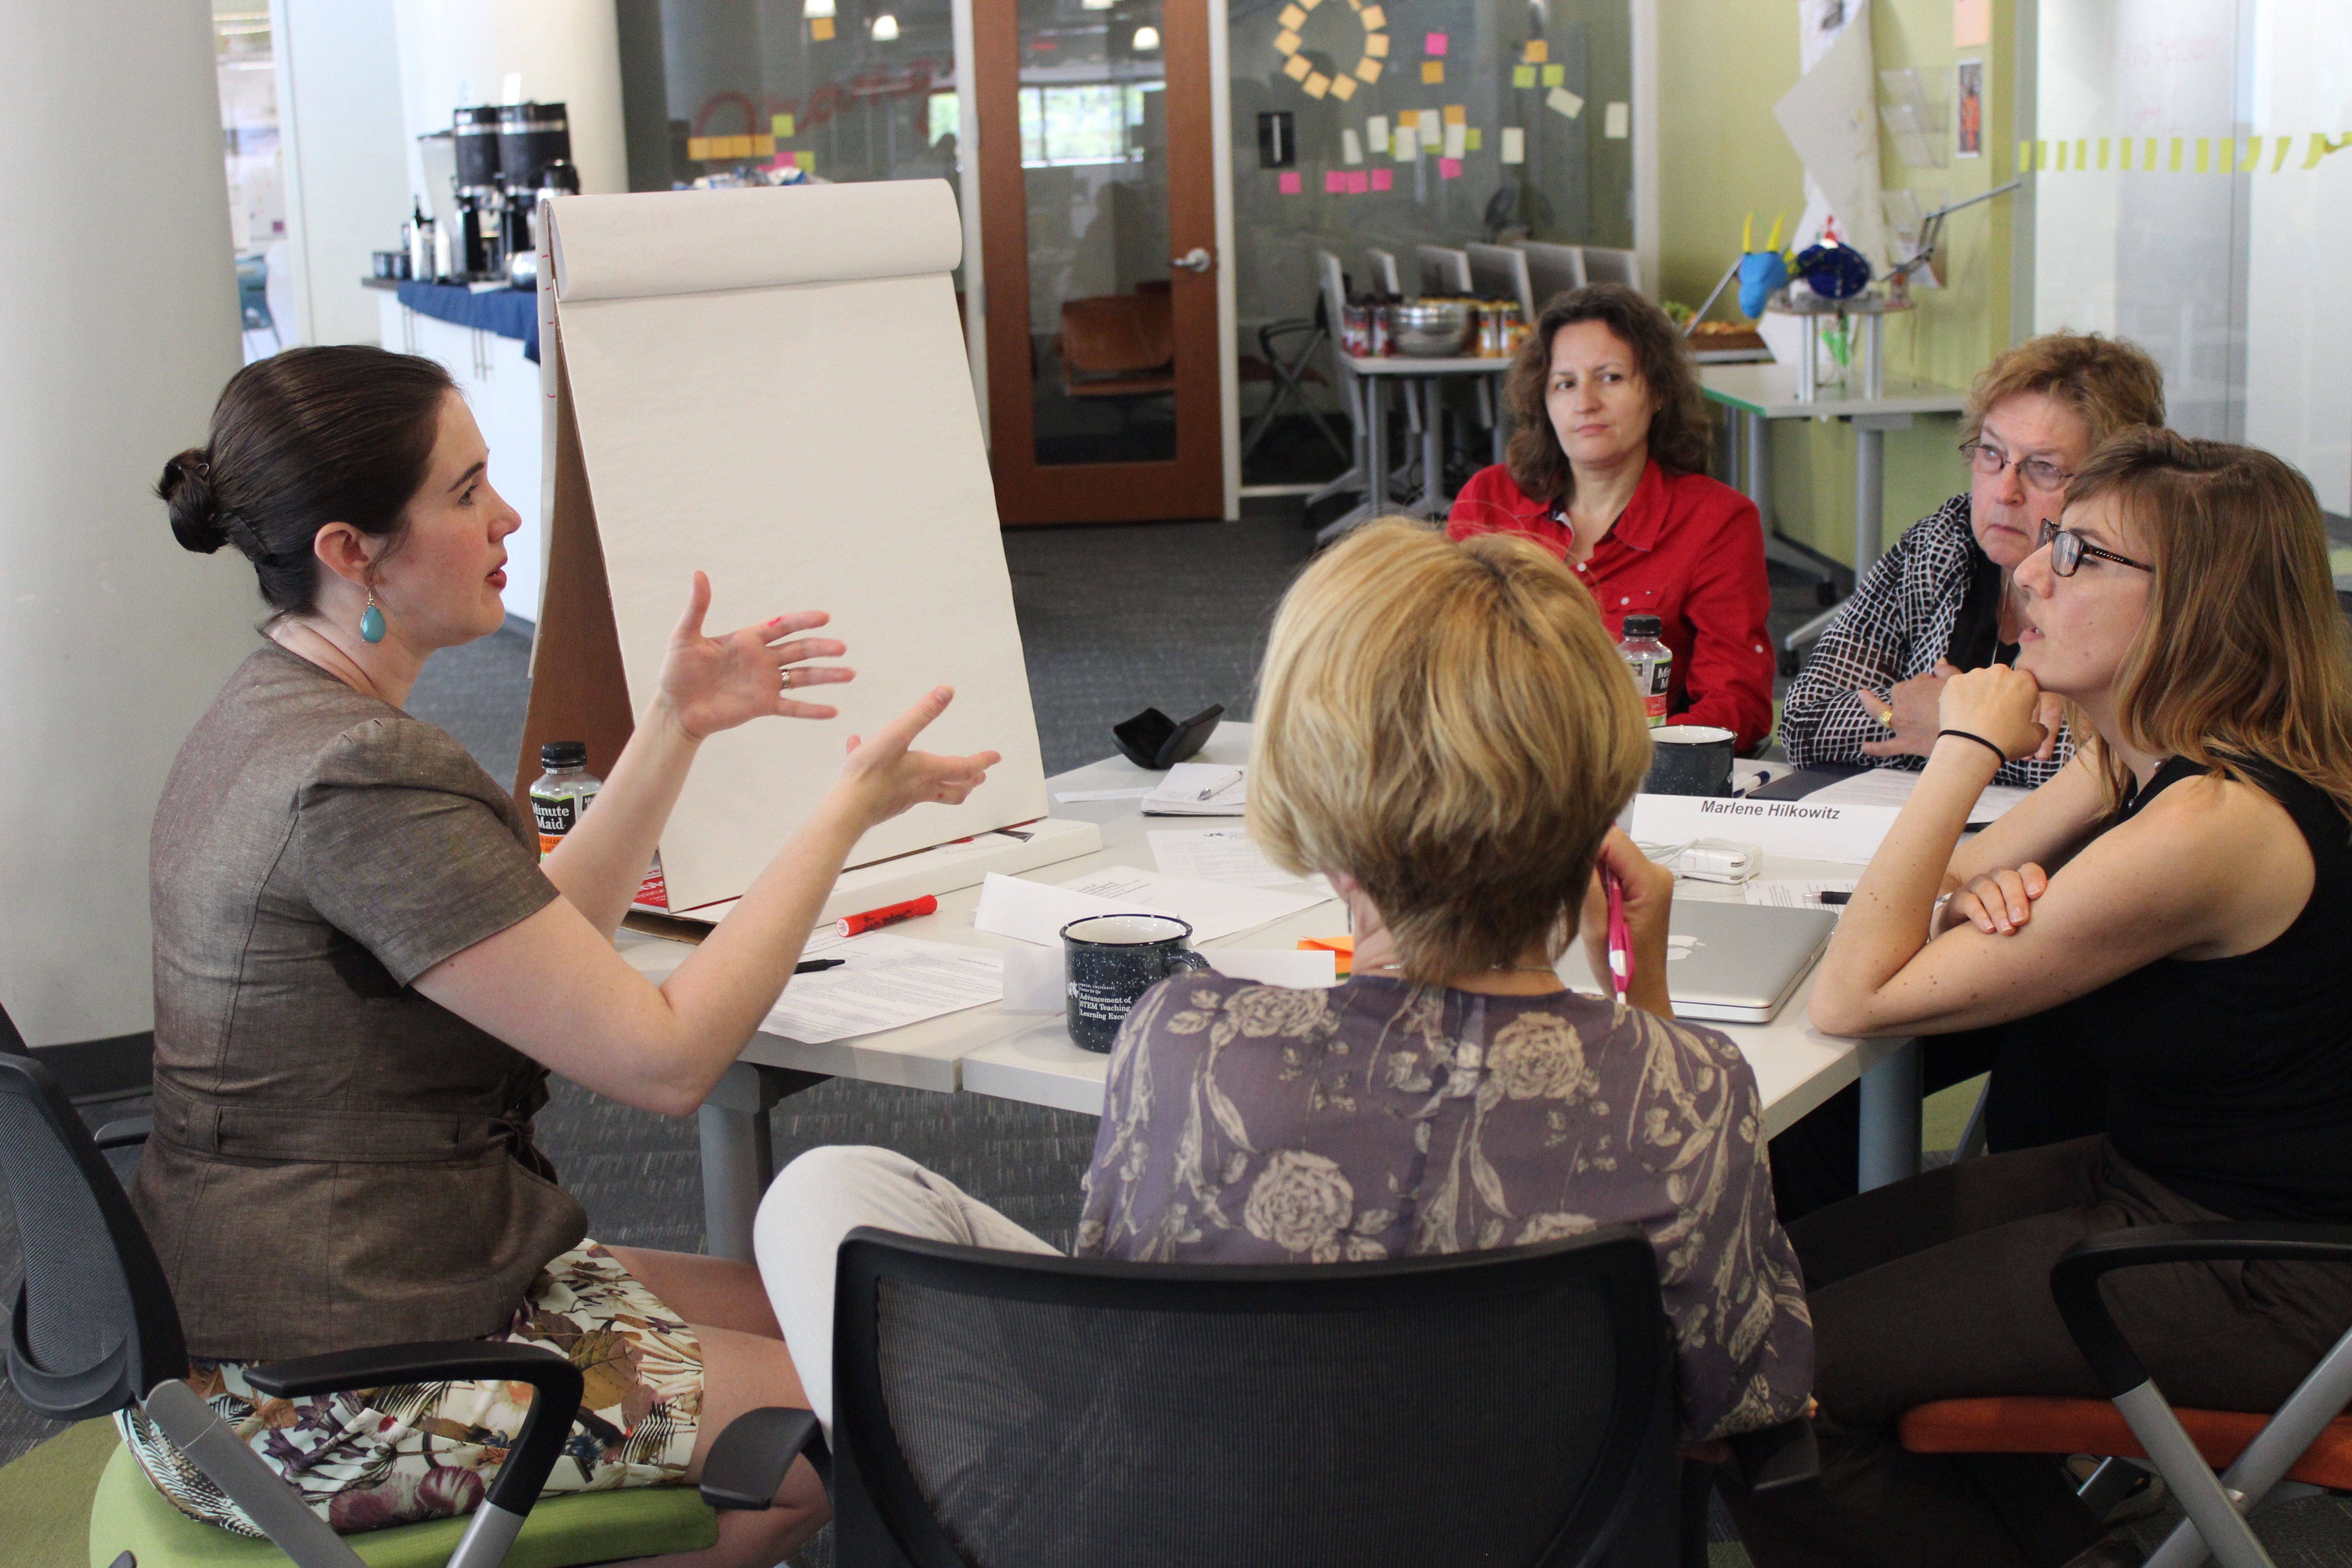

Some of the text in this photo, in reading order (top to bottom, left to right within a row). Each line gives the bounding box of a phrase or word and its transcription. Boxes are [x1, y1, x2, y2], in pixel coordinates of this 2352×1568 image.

[532, 802, 570, 817] Minute
[1701, 800, 1841, 819] Marlene Hilkowitz
[536, 815, 564, 830] Maid
[1080, 993, 1122, 1004] Advancement
[1080, 1000, 1131, 1013] STEM Teaching
[1080, 1009, 1107, 1020] Learning
